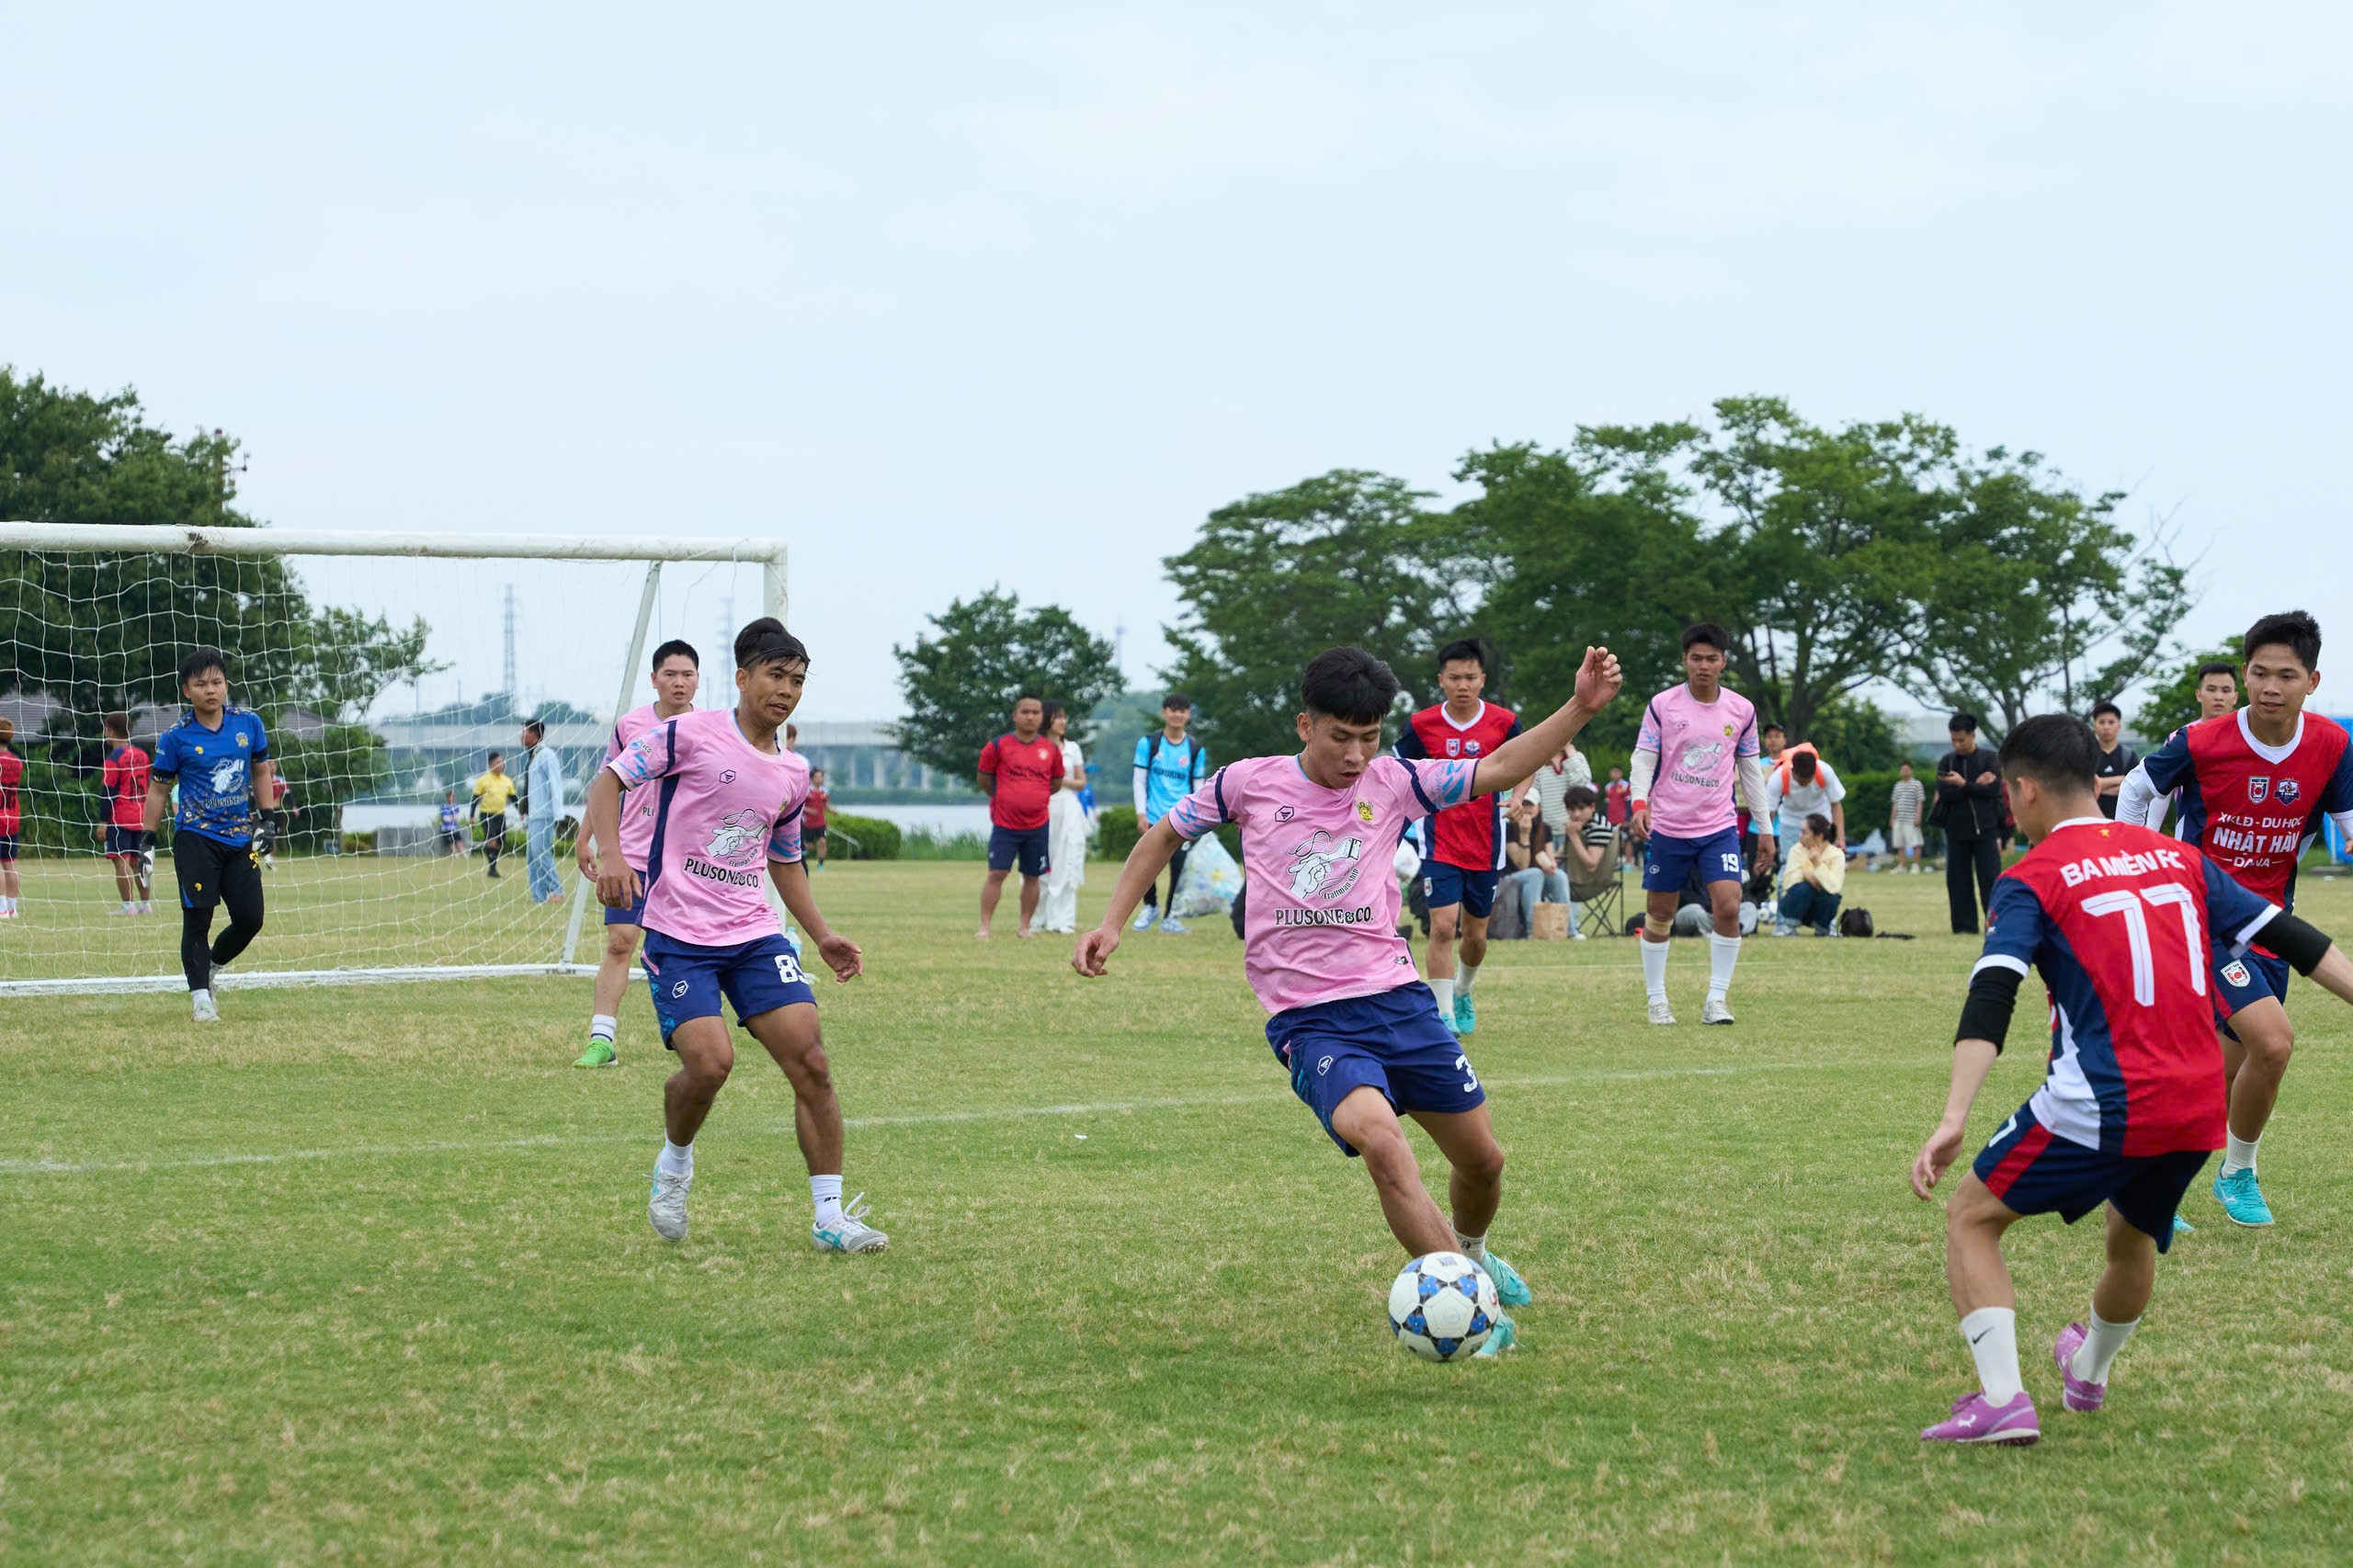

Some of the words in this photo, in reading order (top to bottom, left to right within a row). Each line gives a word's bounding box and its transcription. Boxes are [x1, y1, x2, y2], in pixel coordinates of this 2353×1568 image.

[2262, 817, 2281, 828] DU
[2212, 826, 2268, 856] NHẬT
[1721, 853, 1739, 872] 19
[2060, 858, 2104, 888] BA
[2154, 849, 2187, 870] FC
[1275, 906, 1373, 926] PLUSONE&CO.
[2080, 882, 2206, 1007] 77
